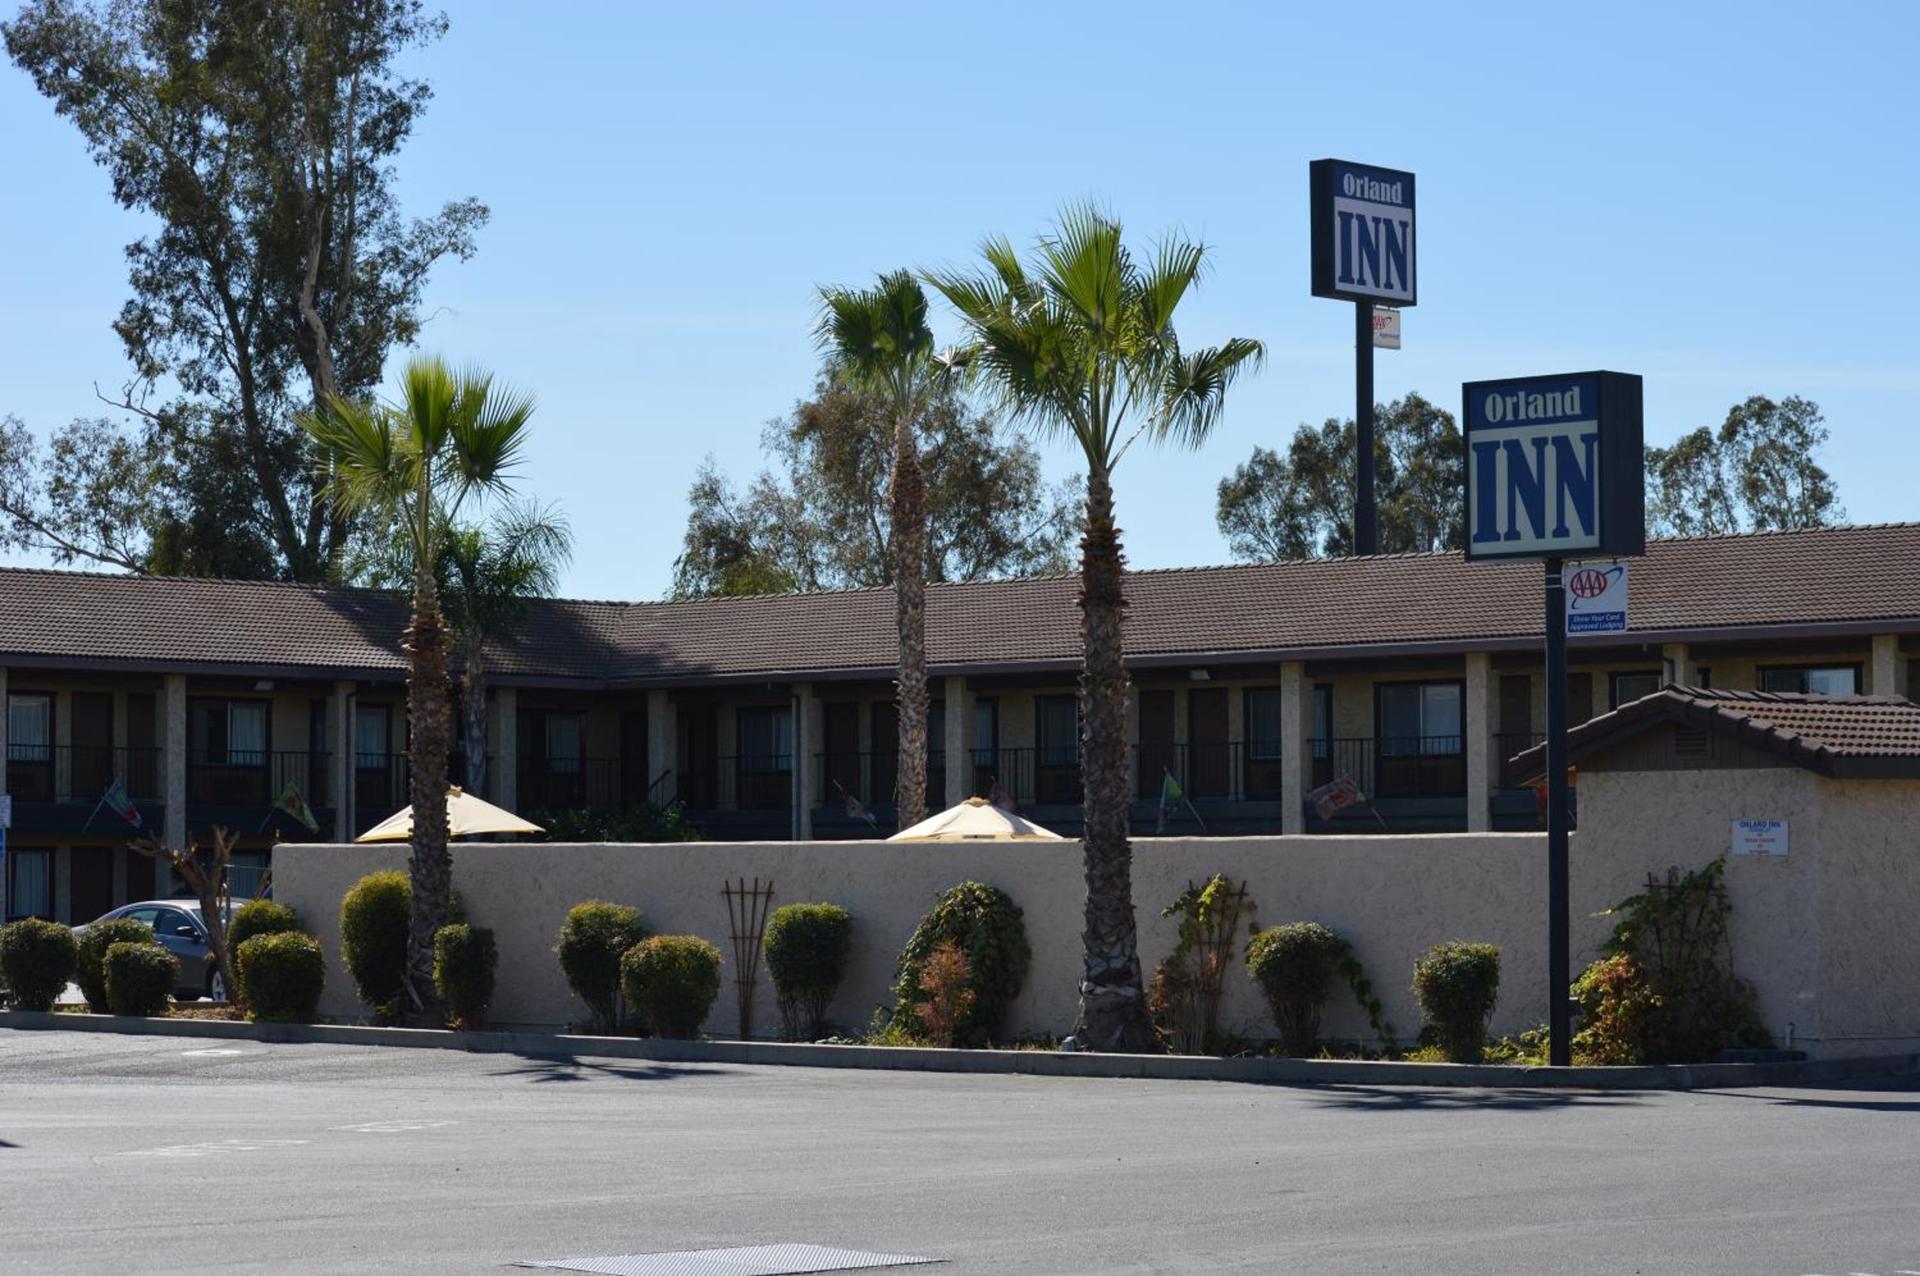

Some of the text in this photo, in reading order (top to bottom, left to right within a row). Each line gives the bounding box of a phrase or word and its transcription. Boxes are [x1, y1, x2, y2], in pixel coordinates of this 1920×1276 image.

[1343, 172, 1402, 204] Orland
[1338, 210, 1409, 292] INN
[1485, 386, 1581, 423] Orland
[1472, 433, 1598, 543] INN
[1572, 570, 1606, 597] AAA
[1739, 820, 1767, 828] ORLAND
